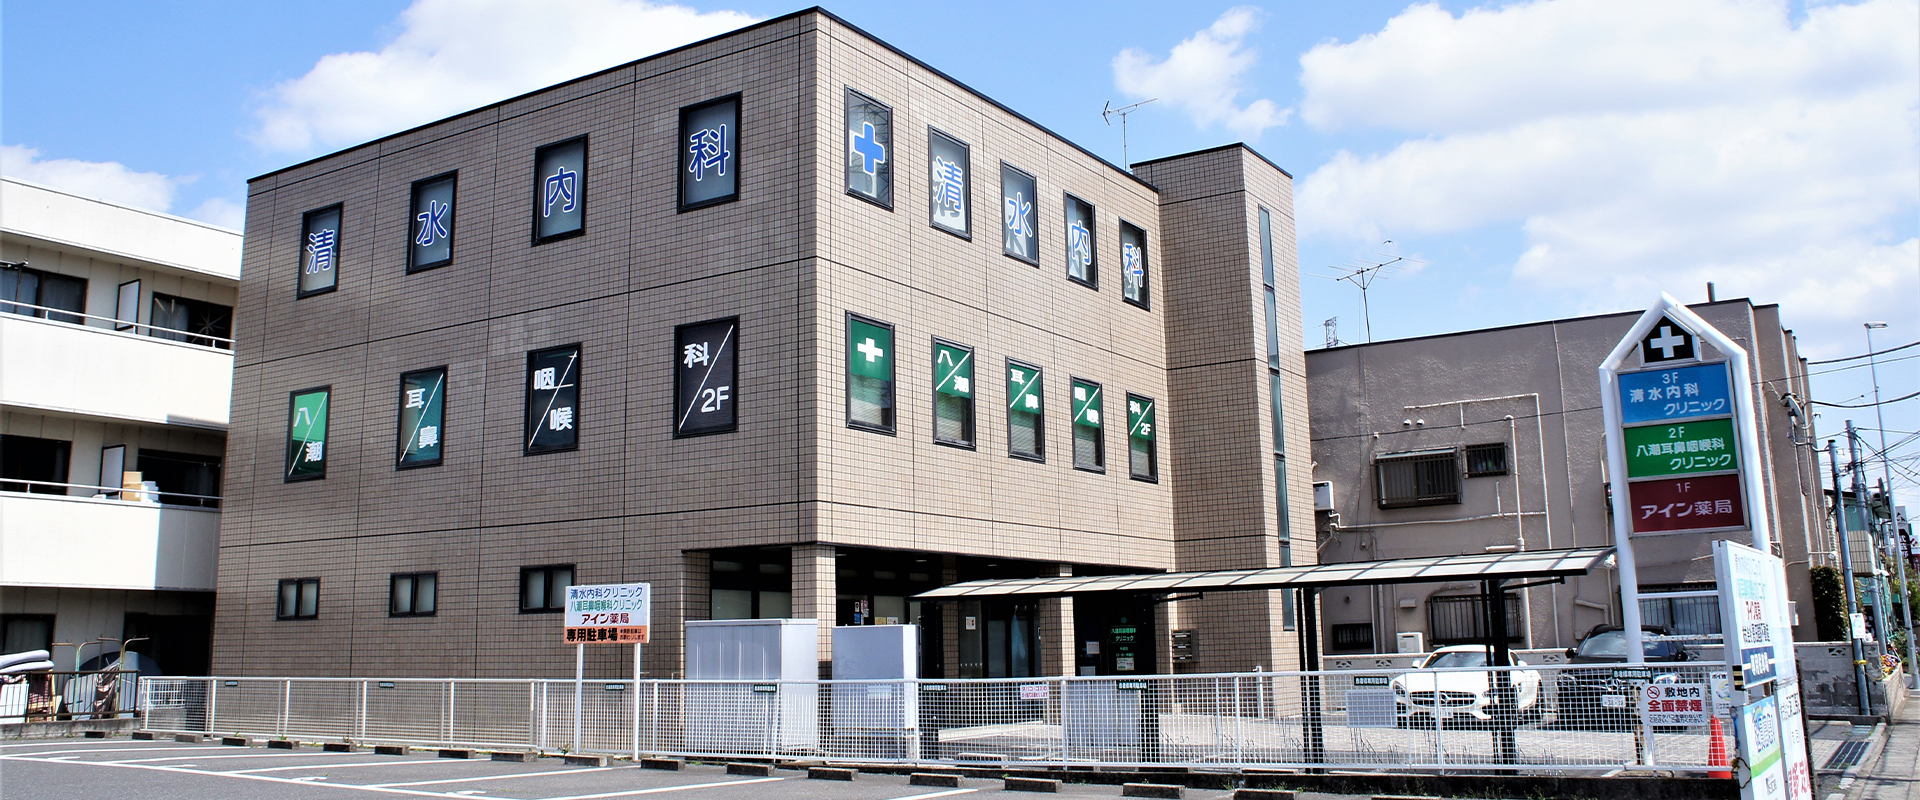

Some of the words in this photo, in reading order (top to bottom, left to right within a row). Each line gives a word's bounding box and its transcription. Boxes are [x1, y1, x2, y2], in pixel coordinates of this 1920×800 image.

[306, 229, 334, 275] 清
[416, 200, 448, 247] 水
[543, 166, 577, 217] 内
[688, 124, 730, 181] 科
[936, 156, 963, 212] 清
[1008, 192, 1032, 237] 水
[1071, 220, 1091, 265] 内
[1123, 243, 1143, 287] 科
[1662, 372, 1679, 384] 3F
[937, 349, 953, 367] 八
[1140, 422, 1151, 435] 2F
[1630, 382, 1700, 403] 清水内科
[294, 407, 311, 427] 八
[304, 441, 323, 462] 潮
[405, 388, 425, 409] 耳
[418, 425, 438, 449] 鼻
[534, 367, 555, 390] 咽
[550, 406, 573, 431] 喉
[684, 341, 709, 368] 科
[701, 385, 730, 413] 2F
[1664, 398, 1725, 415] クリニック
[1668, 426, 1685, 439] 2F
[1636, 437, 1725, 458] 八潮耳鼻咽喉科
[1670, 454, 1732, 471] クリニック
[1676, 482, 1691, 493] 1F
[1641, 499, 1732, 520] アイン薬局
[570, 586, 643, 600] 清水内科クリニック
[581, 612, 630, 625] アイン薬局
[566, 627, 618, 642] 専用駐車場
[1664, 686, 1700, 698] 敷地内
[1648, 699, 1703, 713] 全面禁煙
